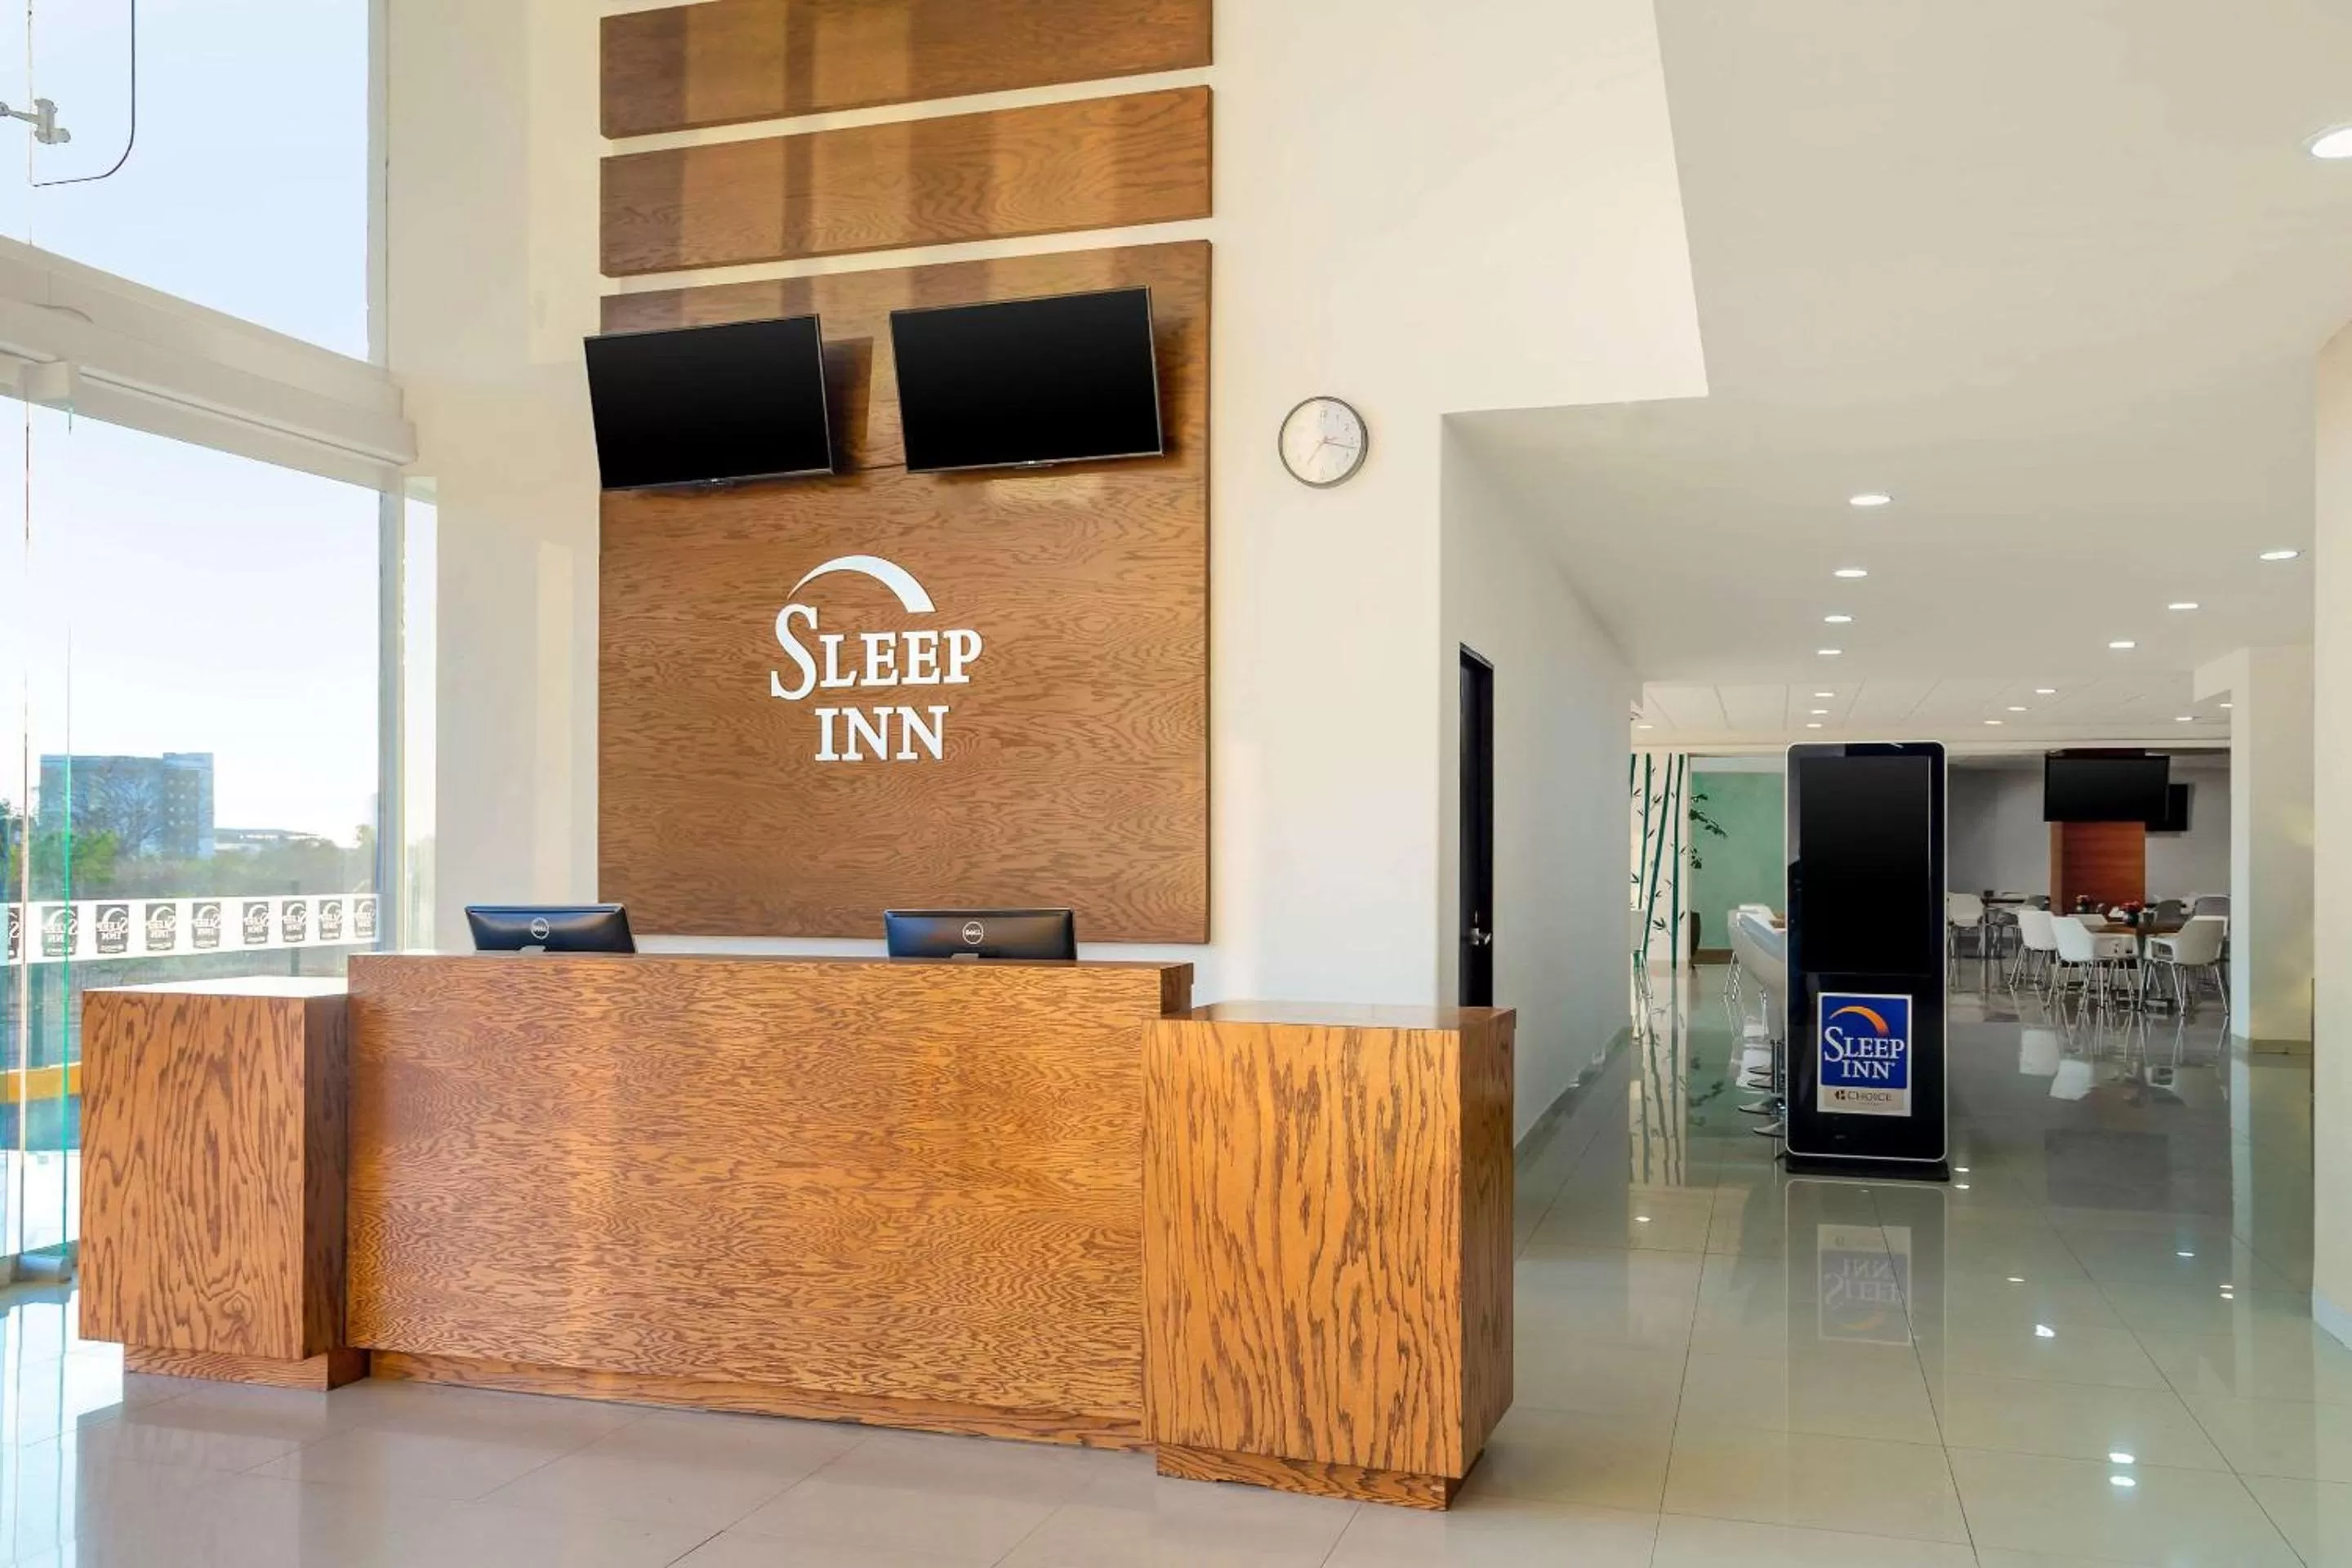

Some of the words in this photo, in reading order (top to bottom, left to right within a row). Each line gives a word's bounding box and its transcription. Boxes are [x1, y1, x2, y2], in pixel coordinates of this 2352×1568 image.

[771, 604, 982, 700] SLEEP
[814, 705, 949, 761] INN
[1824, 1027, 1904, 1062] SLEEP
[1841, 1060, 1891, 1080] INN
